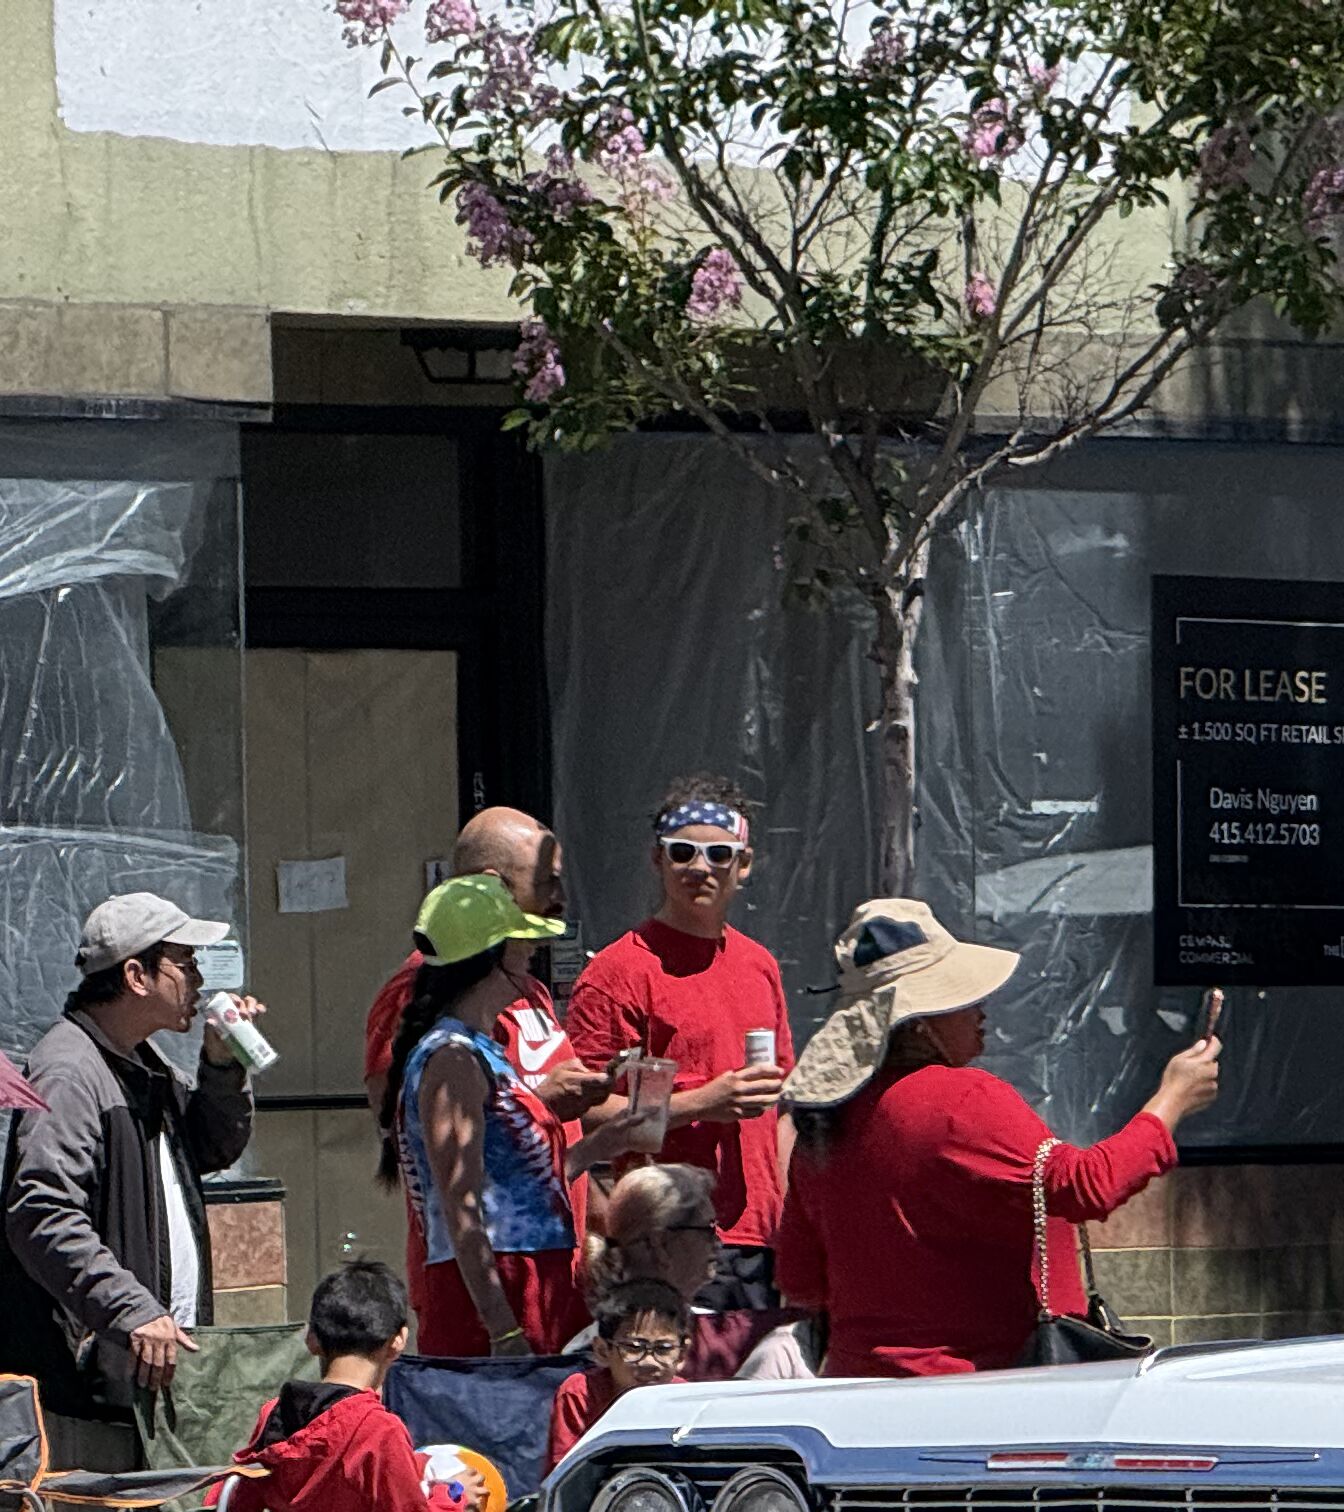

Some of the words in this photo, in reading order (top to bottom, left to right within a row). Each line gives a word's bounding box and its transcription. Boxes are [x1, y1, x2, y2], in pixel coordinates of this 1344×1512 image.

[1179, 666, 1236, 700] FOR
[1244, 669, 1328, 704] LEASE
[1234, 722, 1257, 744] SQ
[1260, 723, 1279, 742] FT
[1281, 724, 1332, 744] RETAIL
[1209, 786, 1253, 809] Davis
[1256, 788, 1318, 815] Nguyen
[1208, 822, 1320, 846] 415.412.5703
